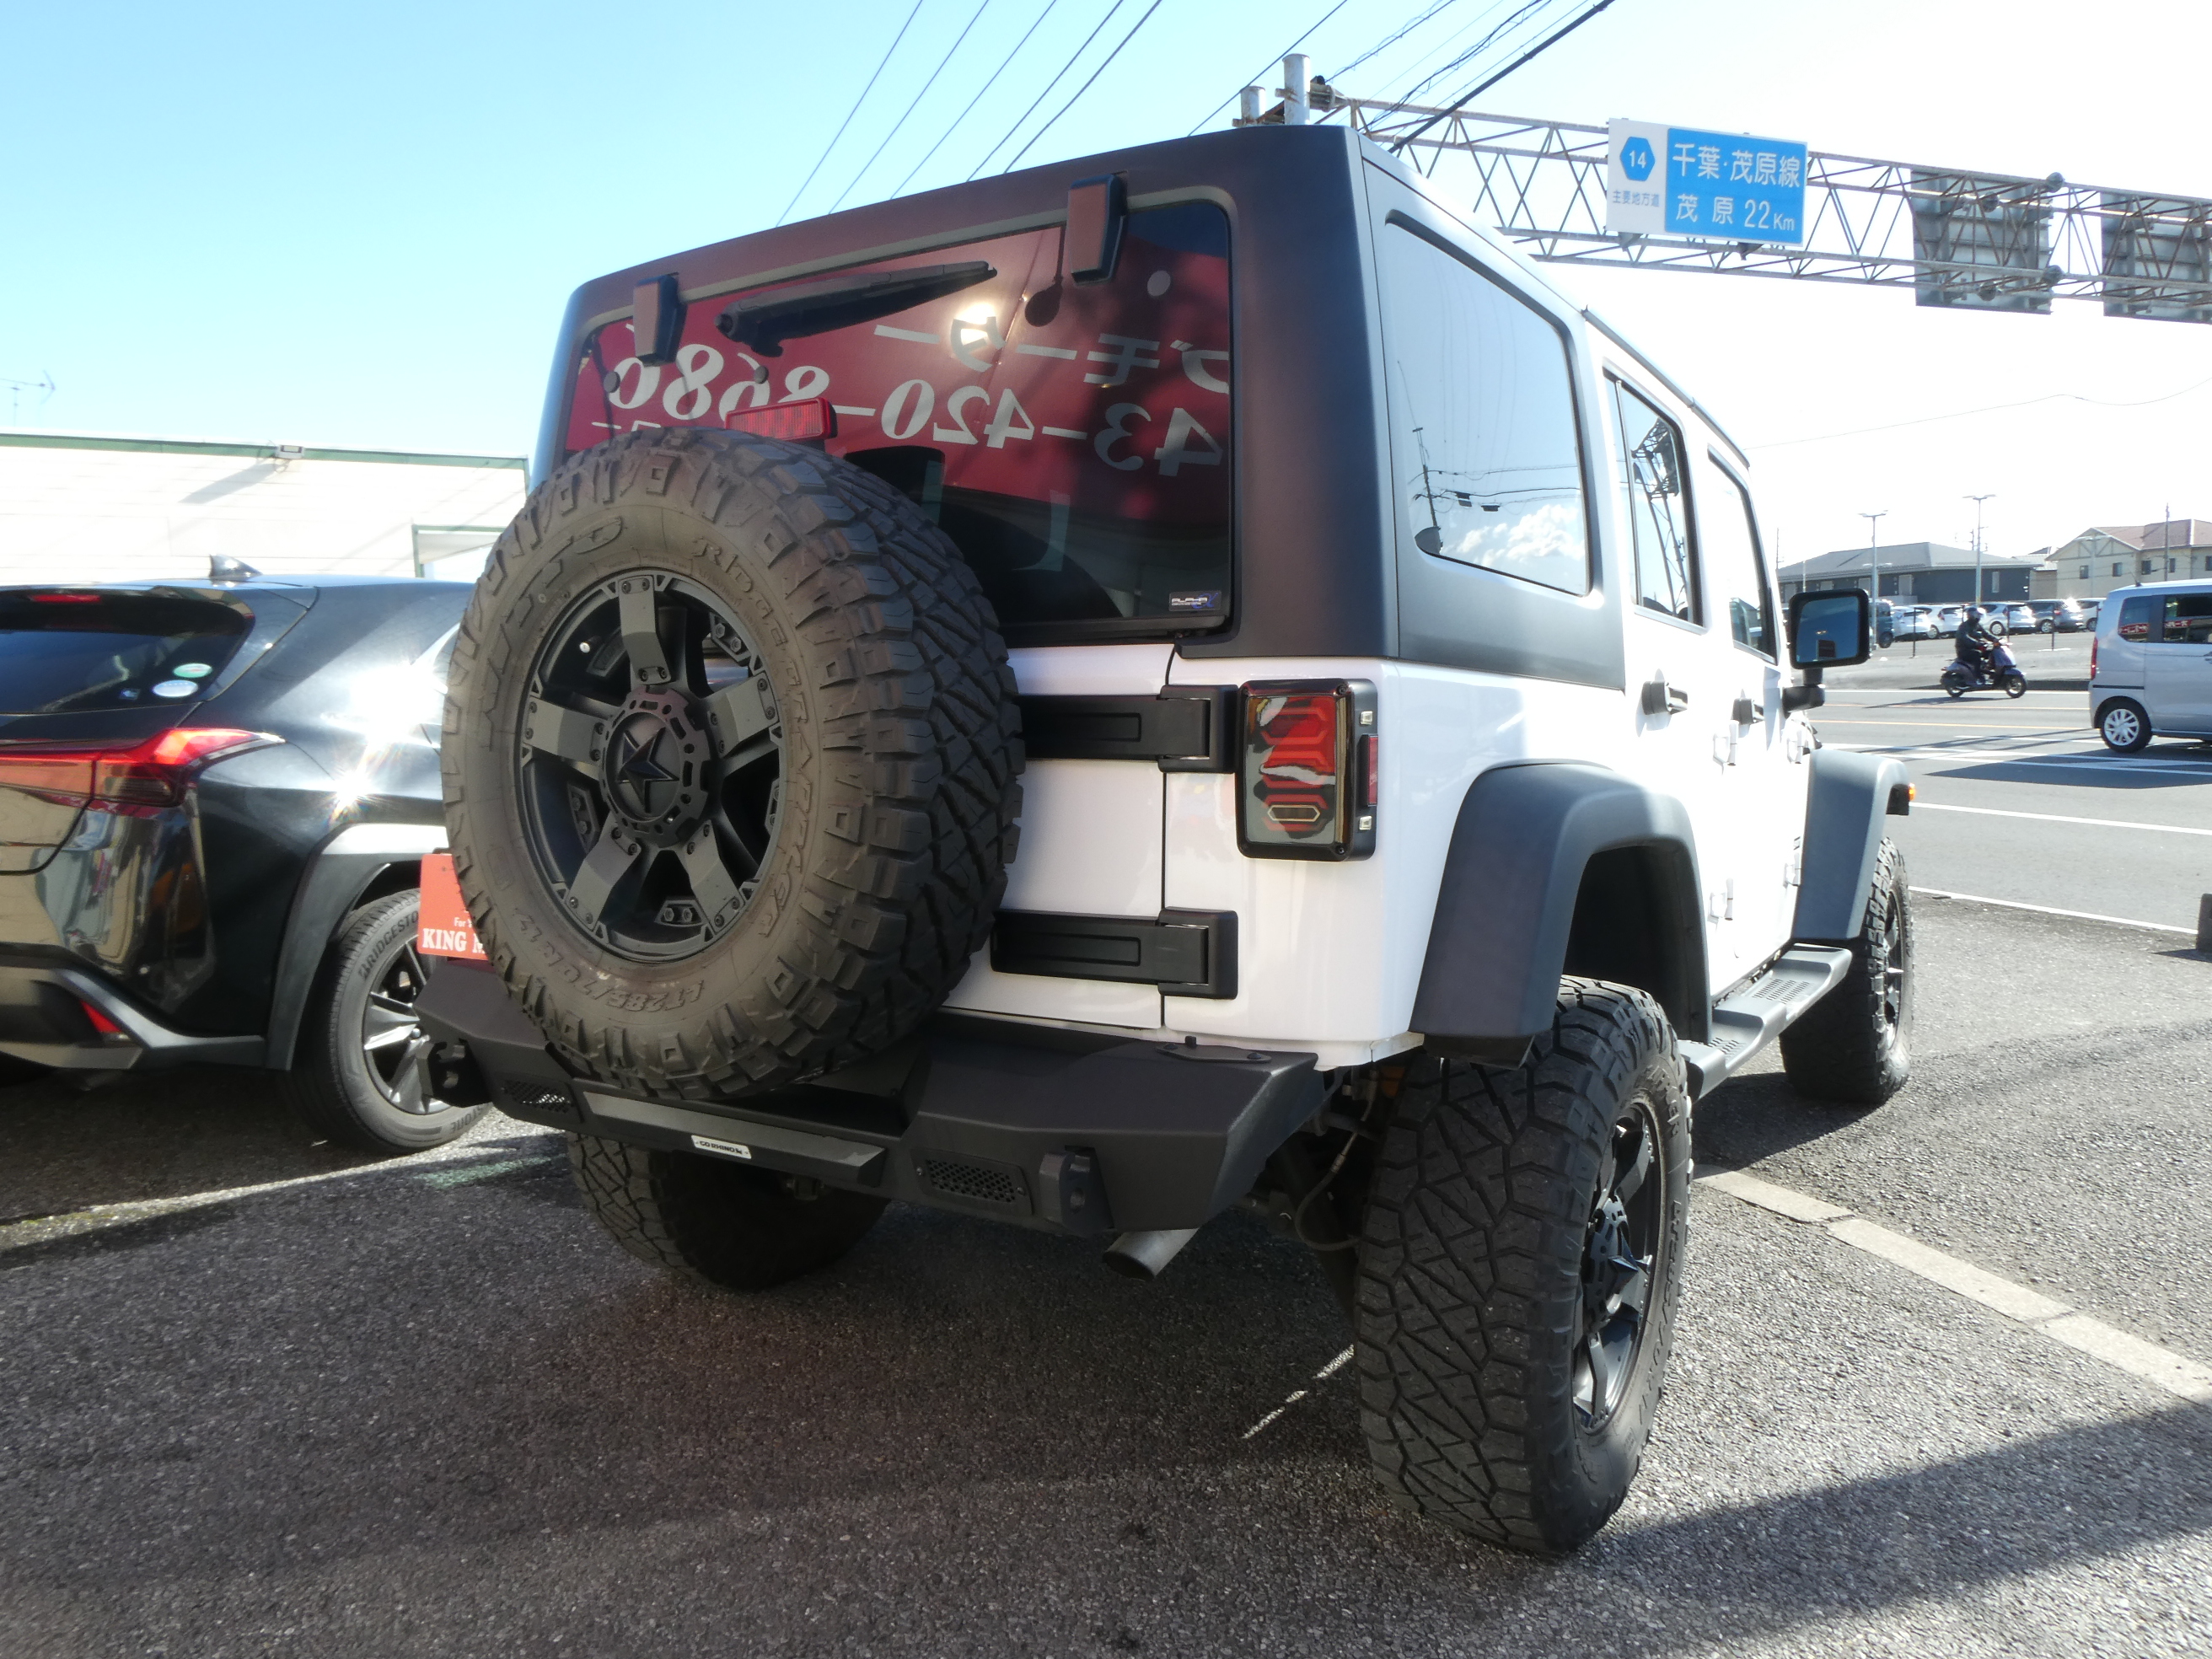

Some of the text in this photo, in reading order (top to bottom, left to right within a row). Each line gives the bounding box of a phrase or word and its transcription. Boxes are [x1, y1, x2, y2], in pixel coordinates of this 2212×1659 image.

[1629, 150, 1646, 169] 14
[1612, 190, 1660, 207] 主要地方道
[454, 916, 466, 927] For
[422, 928, 467, 952] KING
[711, 1143, 735, 1152] RHINO
